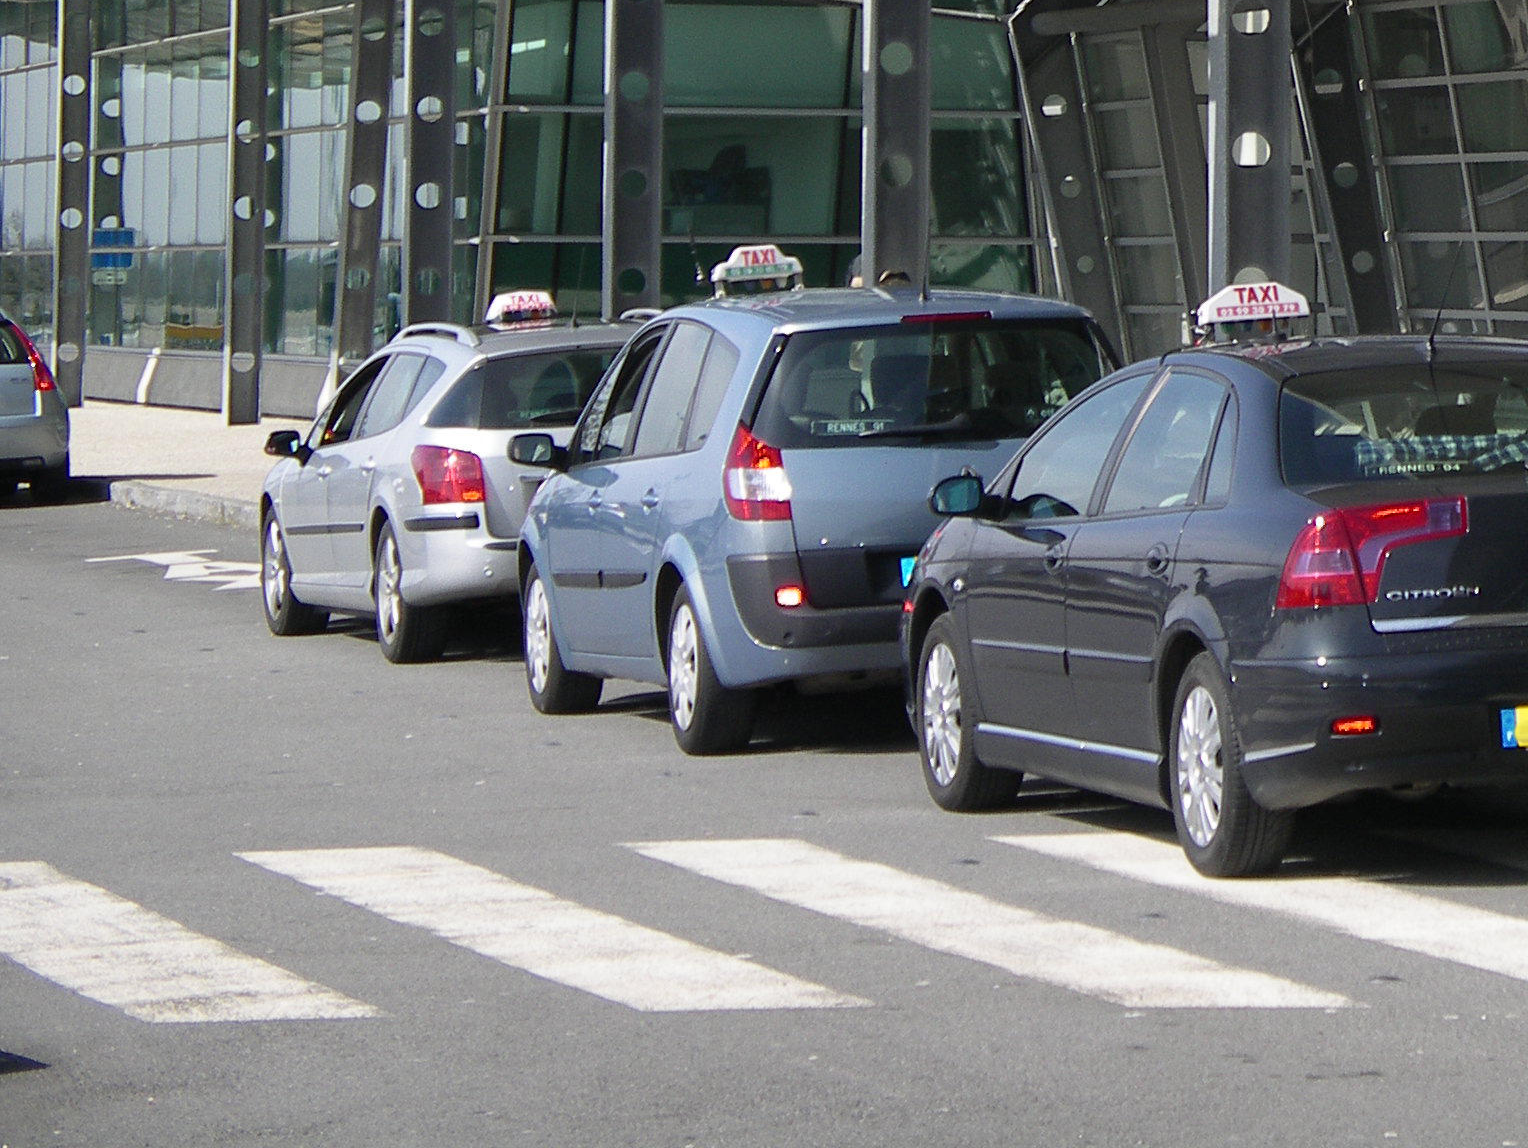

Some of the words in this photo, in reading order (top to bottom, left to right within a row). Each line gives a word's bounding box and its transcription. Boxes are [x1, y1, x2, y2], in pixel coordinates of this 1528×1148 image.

[741, 249, 776, 267] TAXI
[511, 294, 542, 306] TAXI
[1233, 285, 1279, 304] TAXI
[826, 422, 866, 433] RENNES
